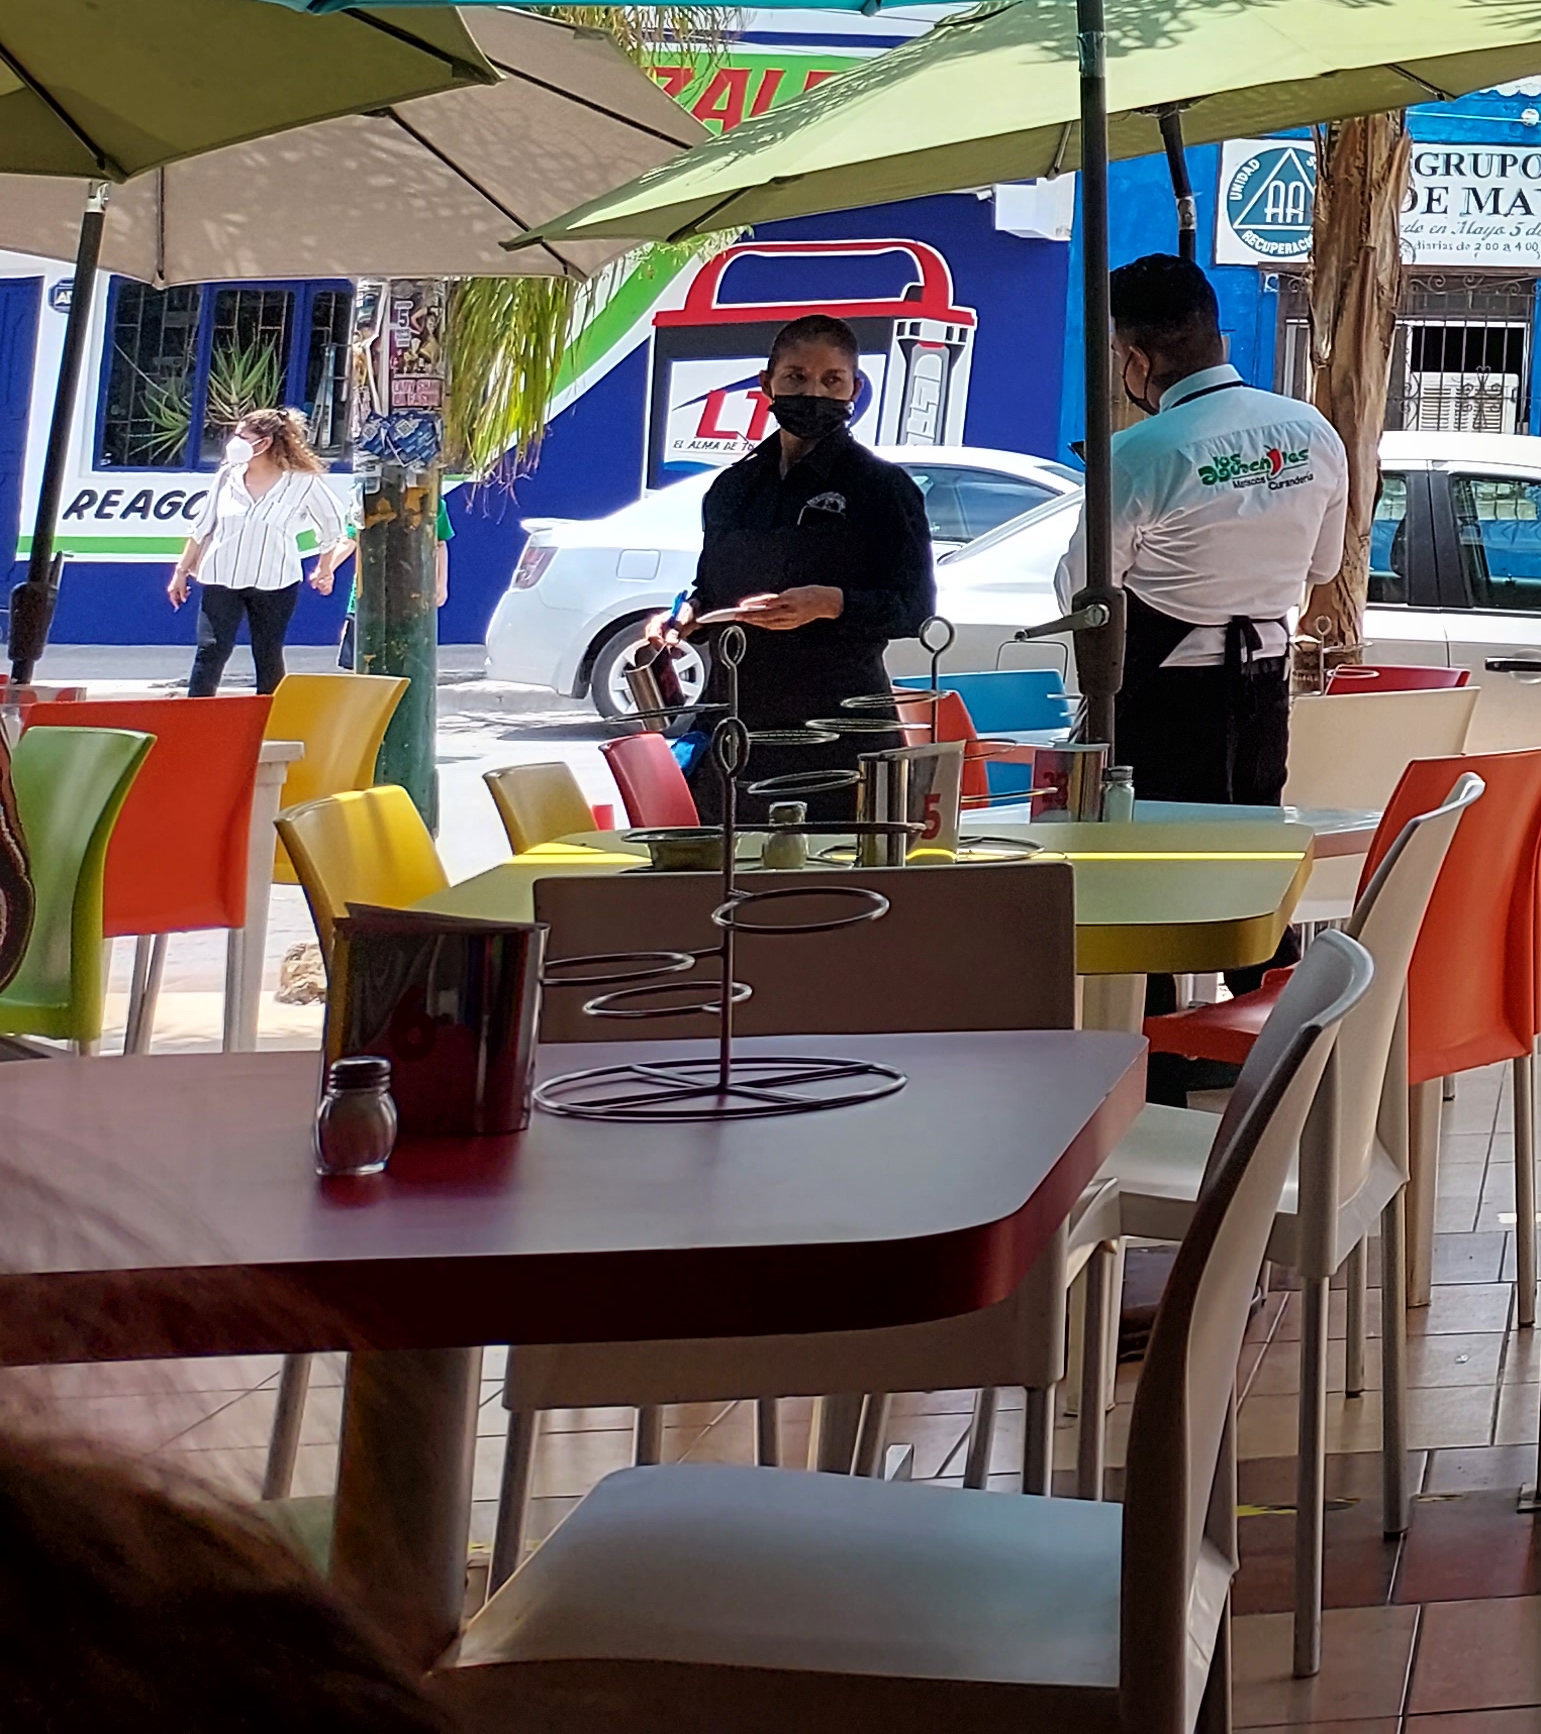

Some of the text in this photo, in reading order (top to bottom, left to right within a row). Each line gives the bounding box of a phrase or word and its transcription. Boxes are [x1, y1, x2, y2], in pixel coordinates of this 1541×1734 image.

[1229, 158, 1261, 201] UNIDAD
[1264, 180, 1306, 224] AA
[1509, 221, 1527, 237] 5
[687, 440, 720, 450] ALMA
[920, 793, 942, 840] 5
